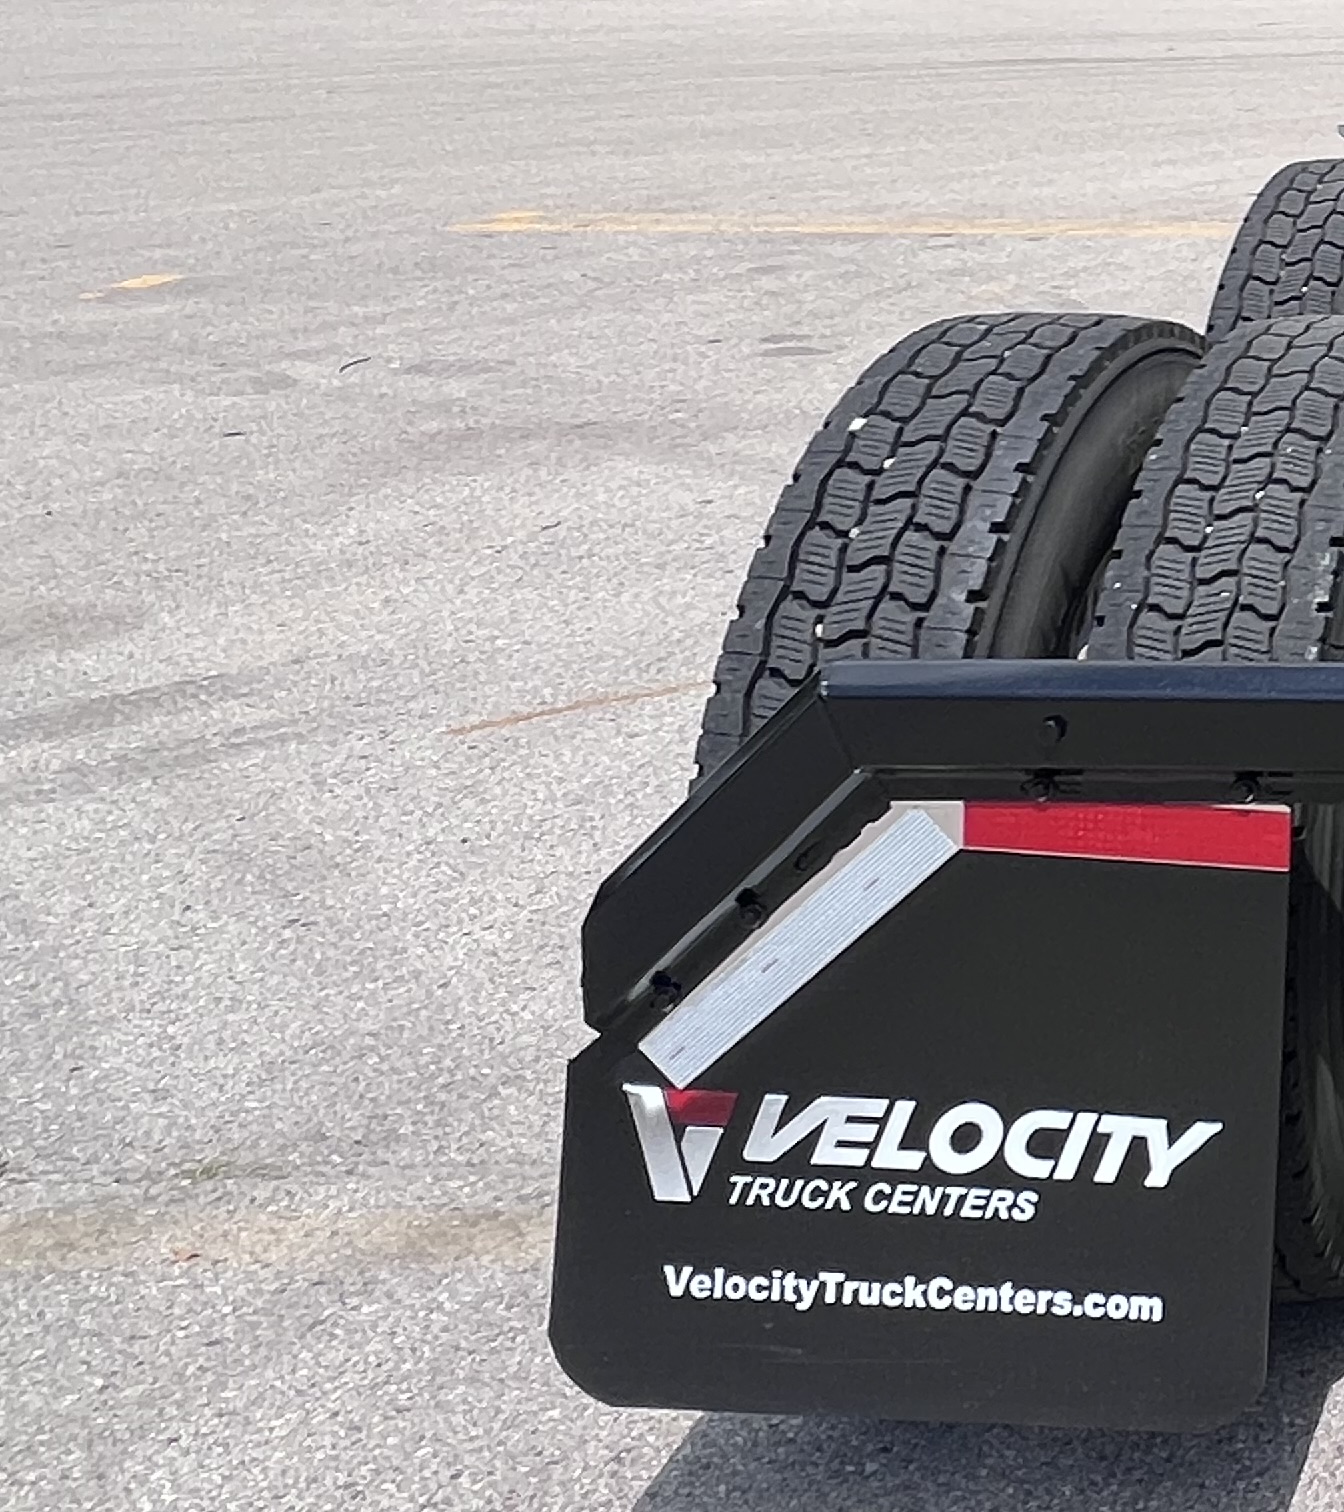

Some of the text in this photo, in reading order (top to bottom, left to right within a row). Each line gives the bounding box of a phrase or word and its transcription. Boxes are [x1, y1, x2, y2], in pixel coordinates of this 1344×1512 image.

[742, 1093, 1224, 1188] VELOCITY
[728, 1174, 1040, 1222] TRUCK CENTERS
[663, 1264, 1164, 1323] VelocityTruckCenters.com
